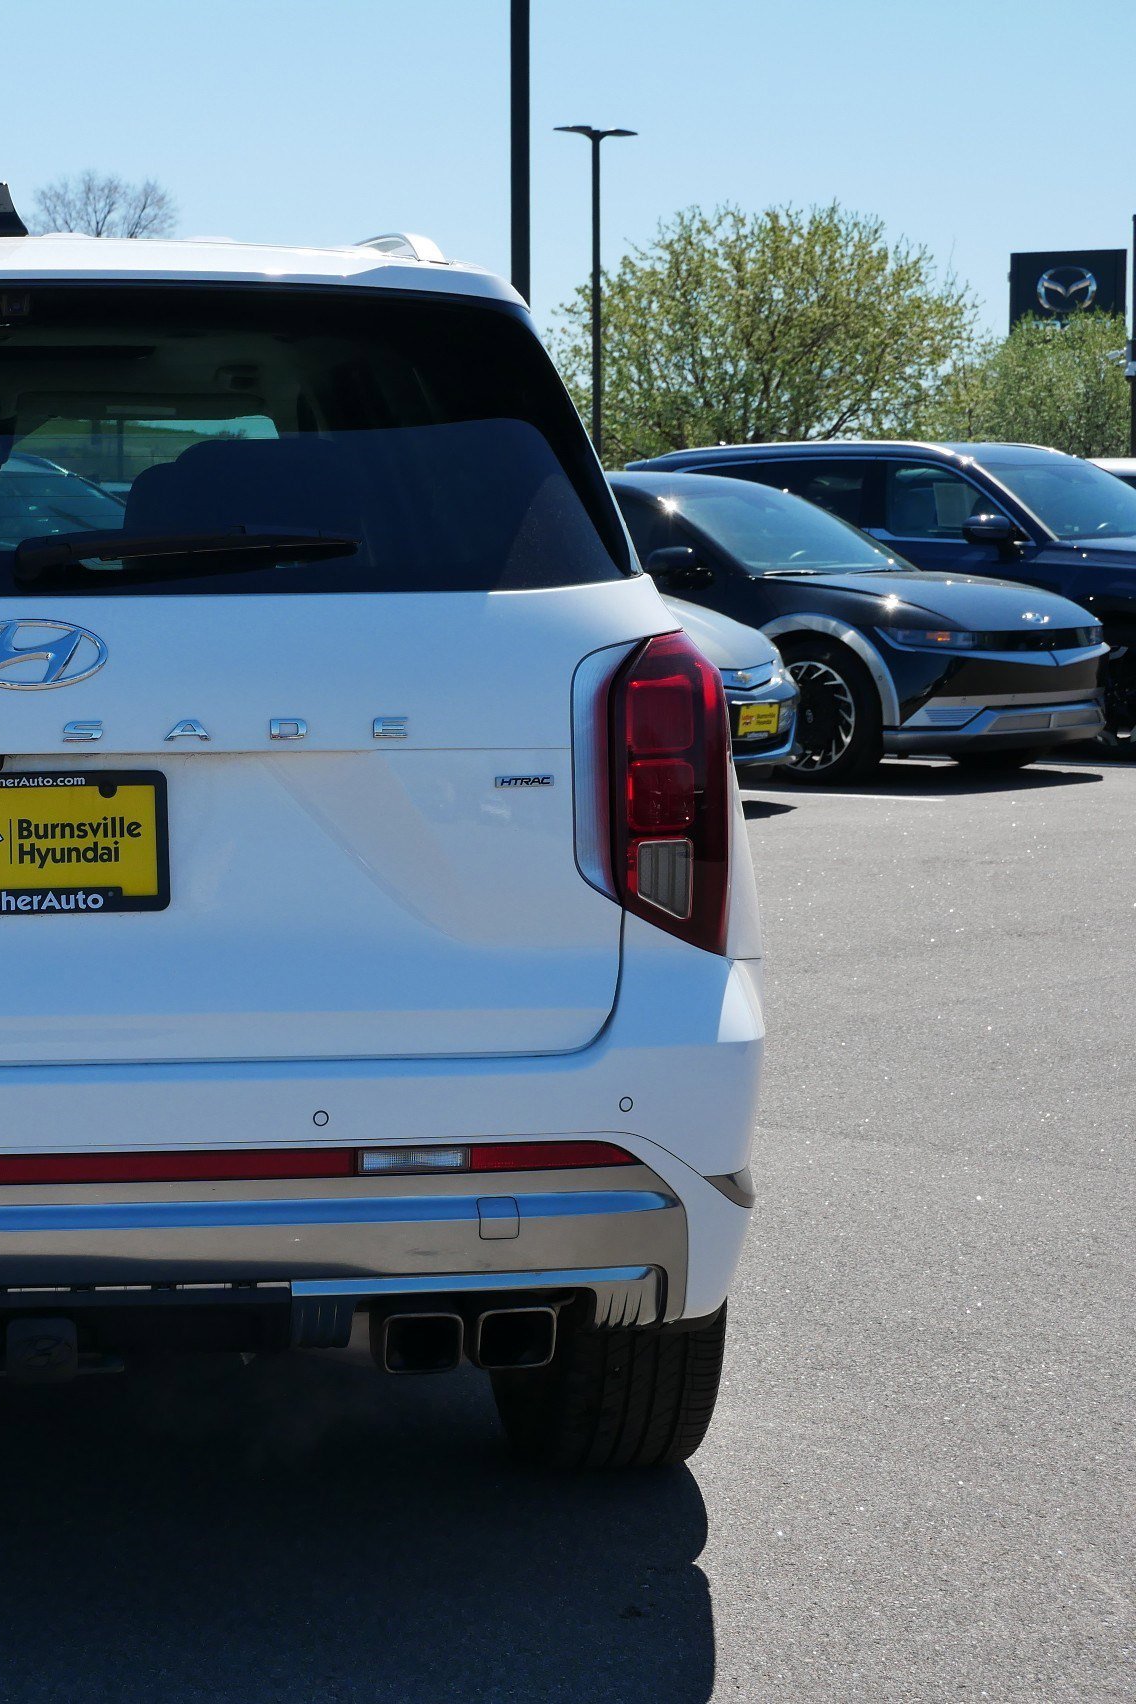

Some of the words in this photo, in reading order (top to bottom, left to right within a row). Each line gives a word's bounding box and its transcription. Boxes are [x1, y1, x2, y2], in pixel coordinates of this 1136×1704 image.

[500, 776, 551, 786] HTRAC
[17, 816, 143, 840] Burnsville
[18, 840, 120, 869] Hyundai
